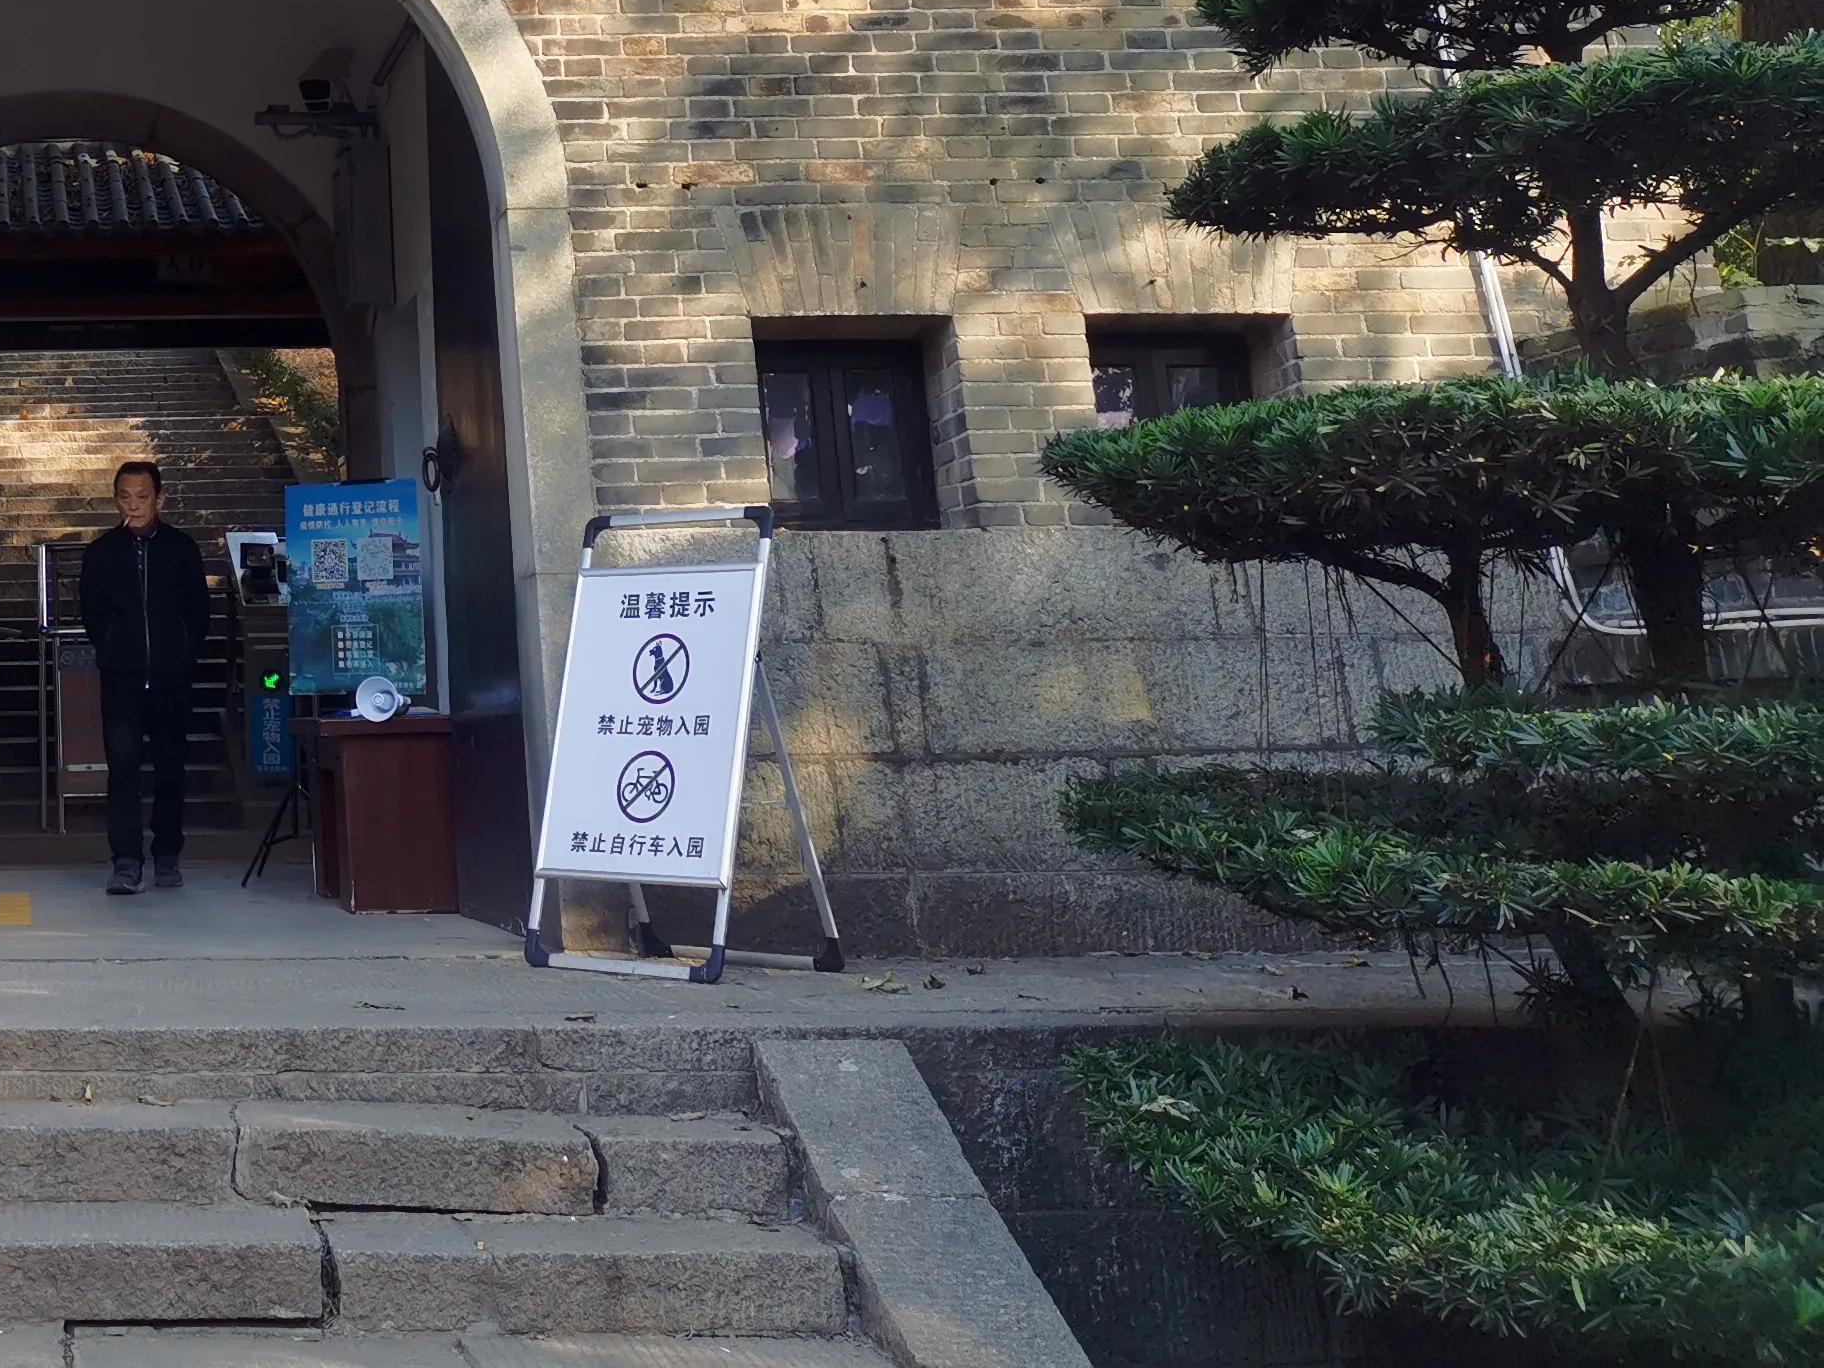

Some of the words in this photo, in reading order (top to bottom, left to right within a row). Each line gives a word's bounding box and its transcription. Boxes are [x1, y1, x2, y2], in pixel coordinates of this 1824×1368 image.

[303, 499, 400, 517] 健康通行登记流程
[619, 590, 717, 620] 温馨提示
[596, 713, 711, 737] 禁止宠物入园
[570, 831, 705, 859] 禁止自行车入园
